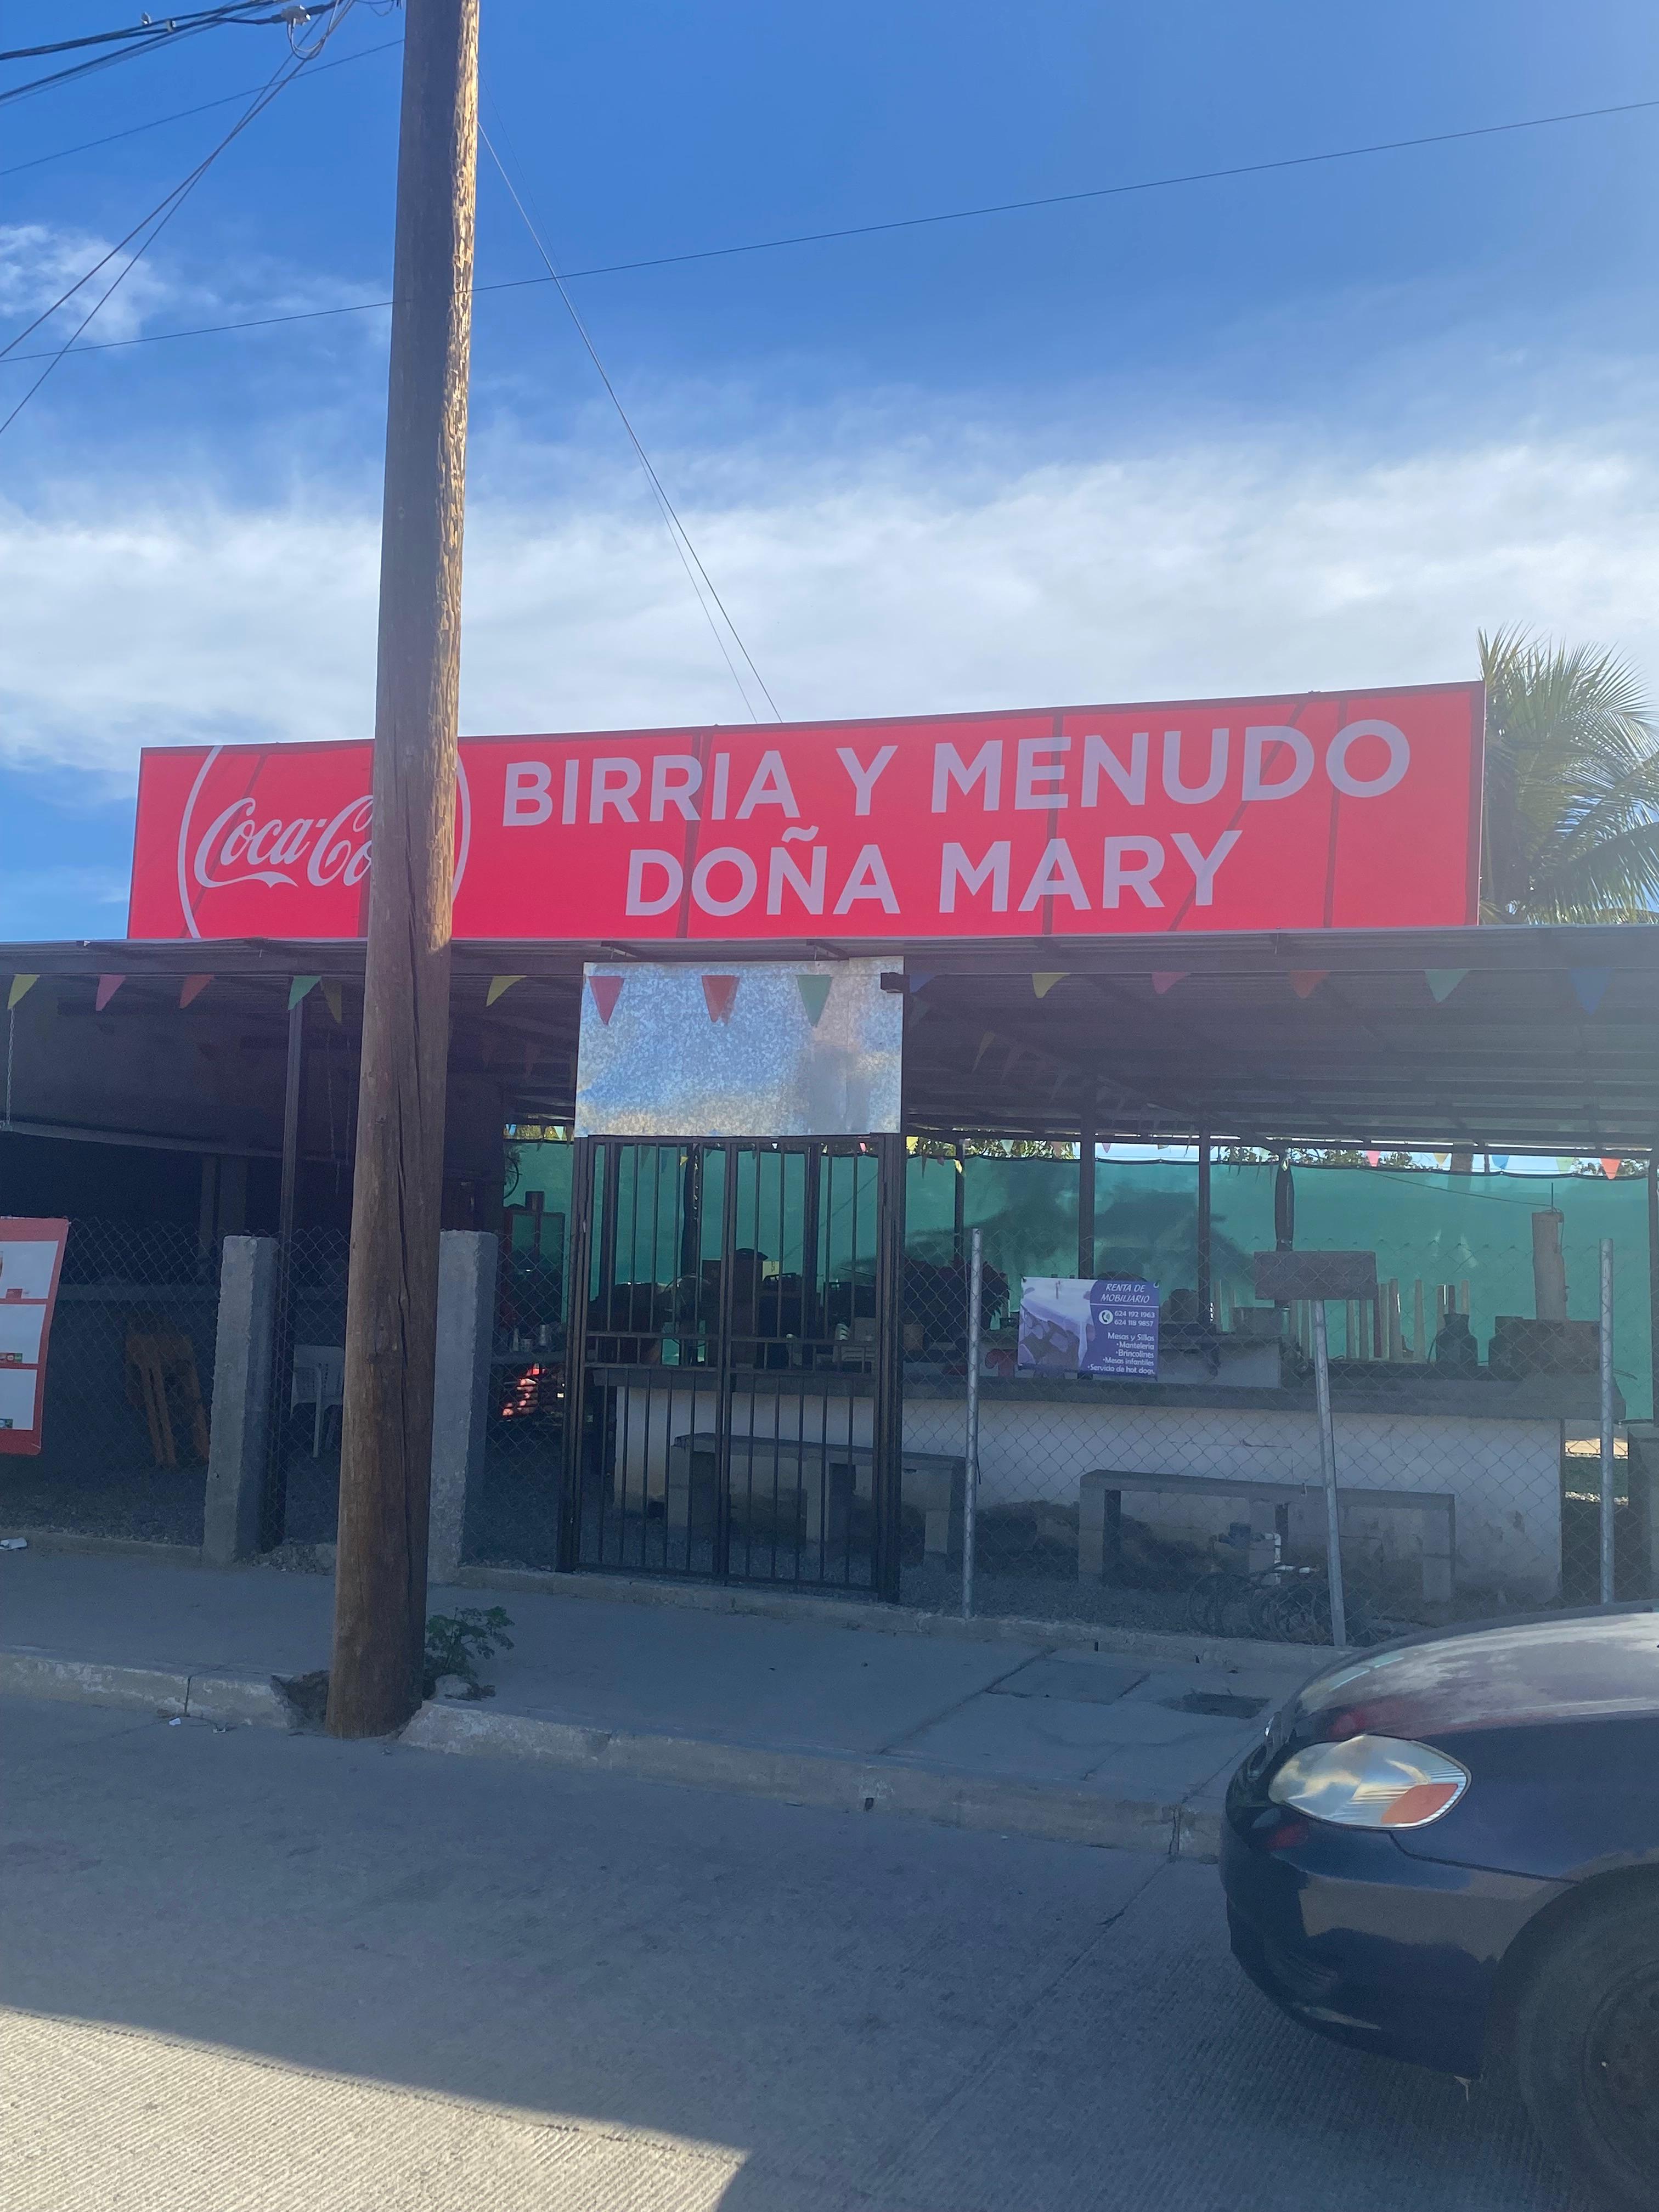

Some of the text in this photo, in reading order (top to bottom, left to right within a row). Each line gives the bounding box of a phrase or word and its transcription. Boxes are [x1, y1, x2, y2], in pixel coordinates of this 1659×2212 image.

[503, 719, 1410, 827] BIRRIA Y MENUDO
[194, 794, 374, 888] Coca-Co
[625, 825, 1244, 917] DOÑA MARY
[1101, 1294, 1150, 1303] MOBILIARIO
[1106, 1283, 1131, 1292] RENTA
[1119, 1349, 1154, 1358] Brincolines
